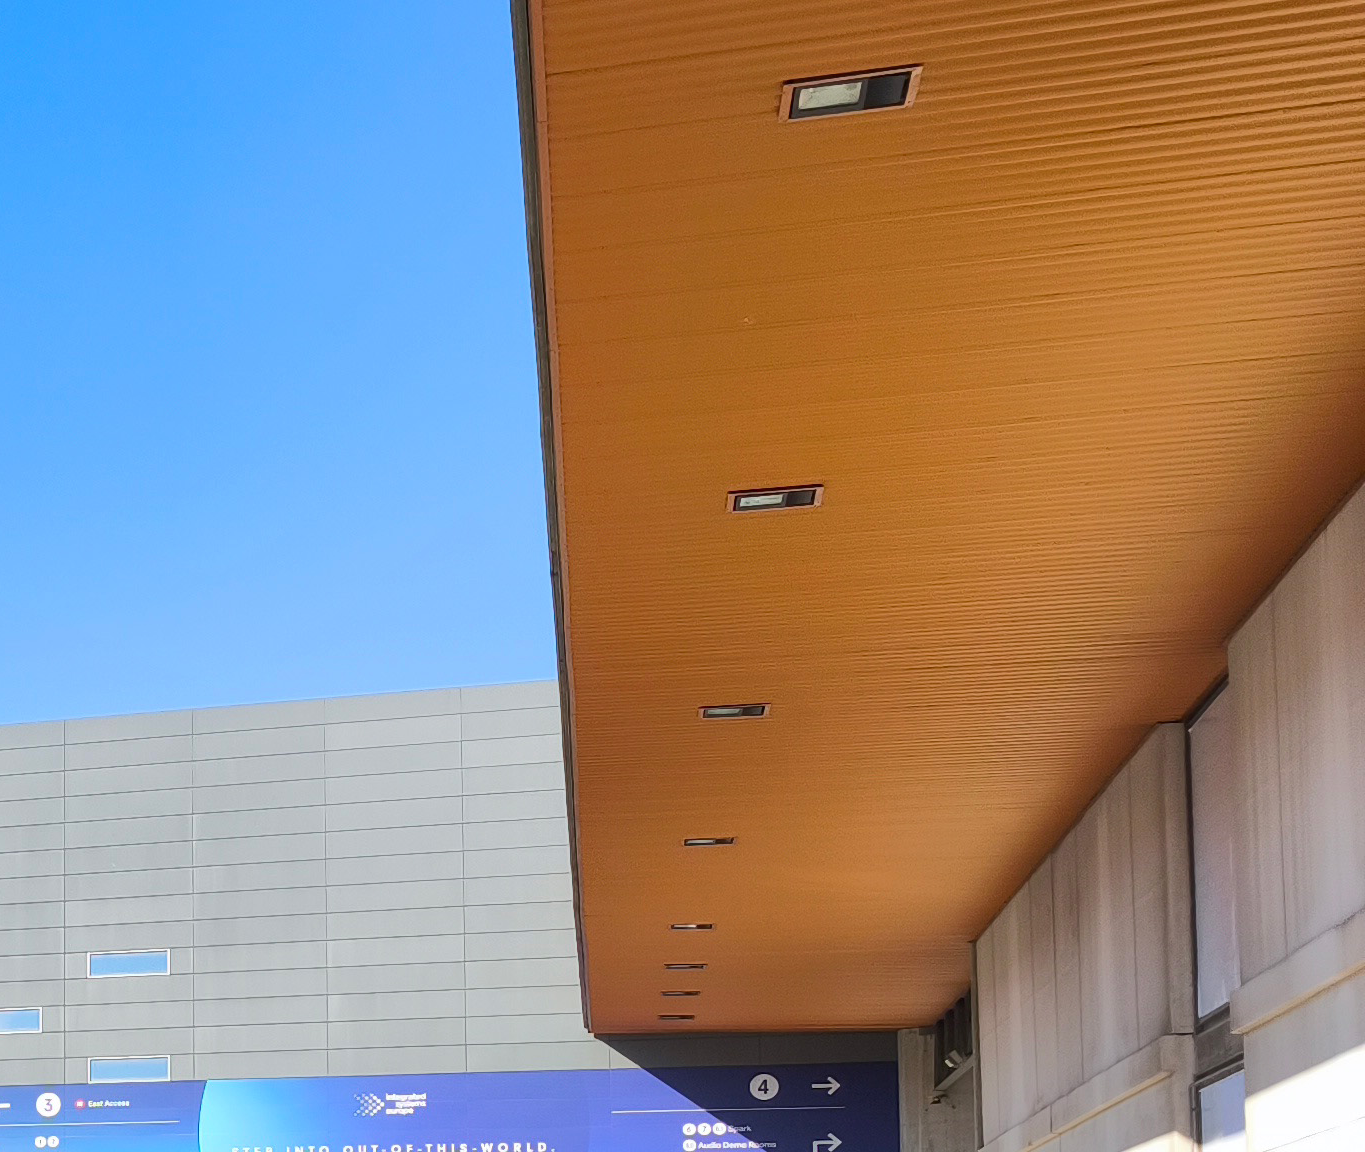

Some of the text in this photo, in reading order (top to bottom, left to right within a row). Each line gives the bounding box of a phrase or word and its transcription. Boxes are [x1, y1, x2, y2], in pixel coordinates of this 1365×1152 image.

[757, 1079, 769, 1095] 4
[44, 1098, 53, 1112] 3
[727, 1125, 752, 1133] Spark
